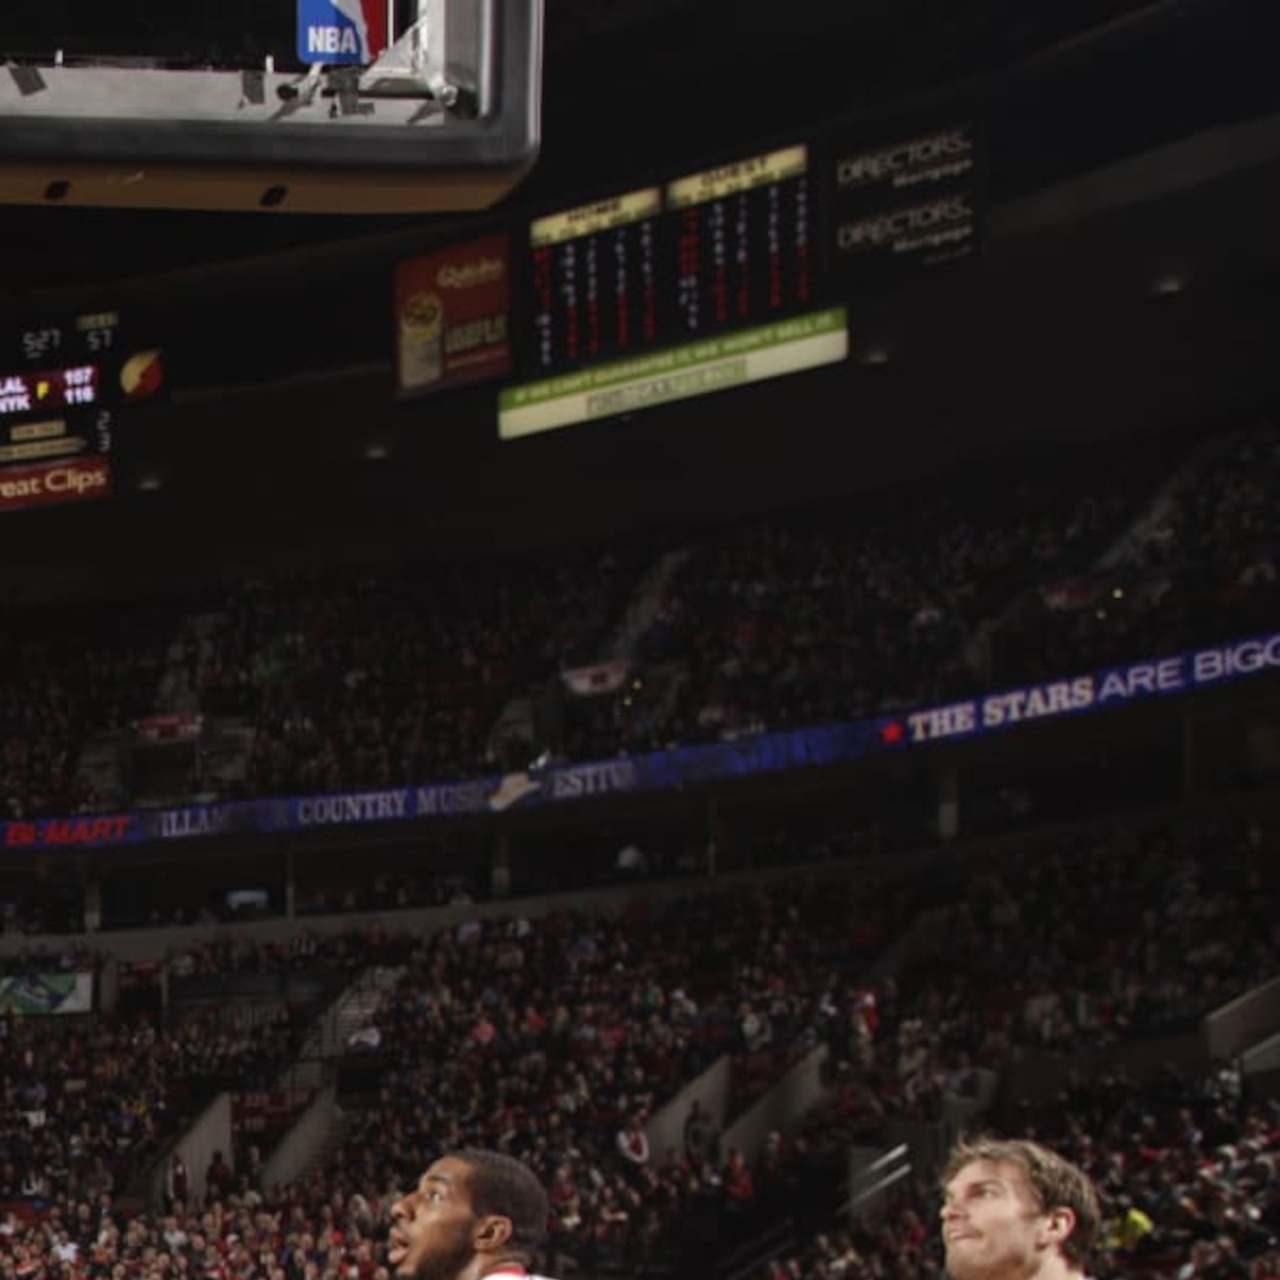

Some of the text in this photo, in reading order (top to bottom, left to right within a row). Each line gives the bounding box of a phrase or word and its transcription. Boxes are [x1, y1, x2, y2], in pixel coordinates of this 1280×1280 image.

[308, 26, 357, 54] NBA
[44, 468, 108, 494] Clips
[908, 703, 976, 742] THE
[982, 674, 1095, 728] STARS
[1098, 656, 1186, 701] ARE
[297, 790, 409, 825] COUNTRY
[5, 817, 133, 848] BI-MART
